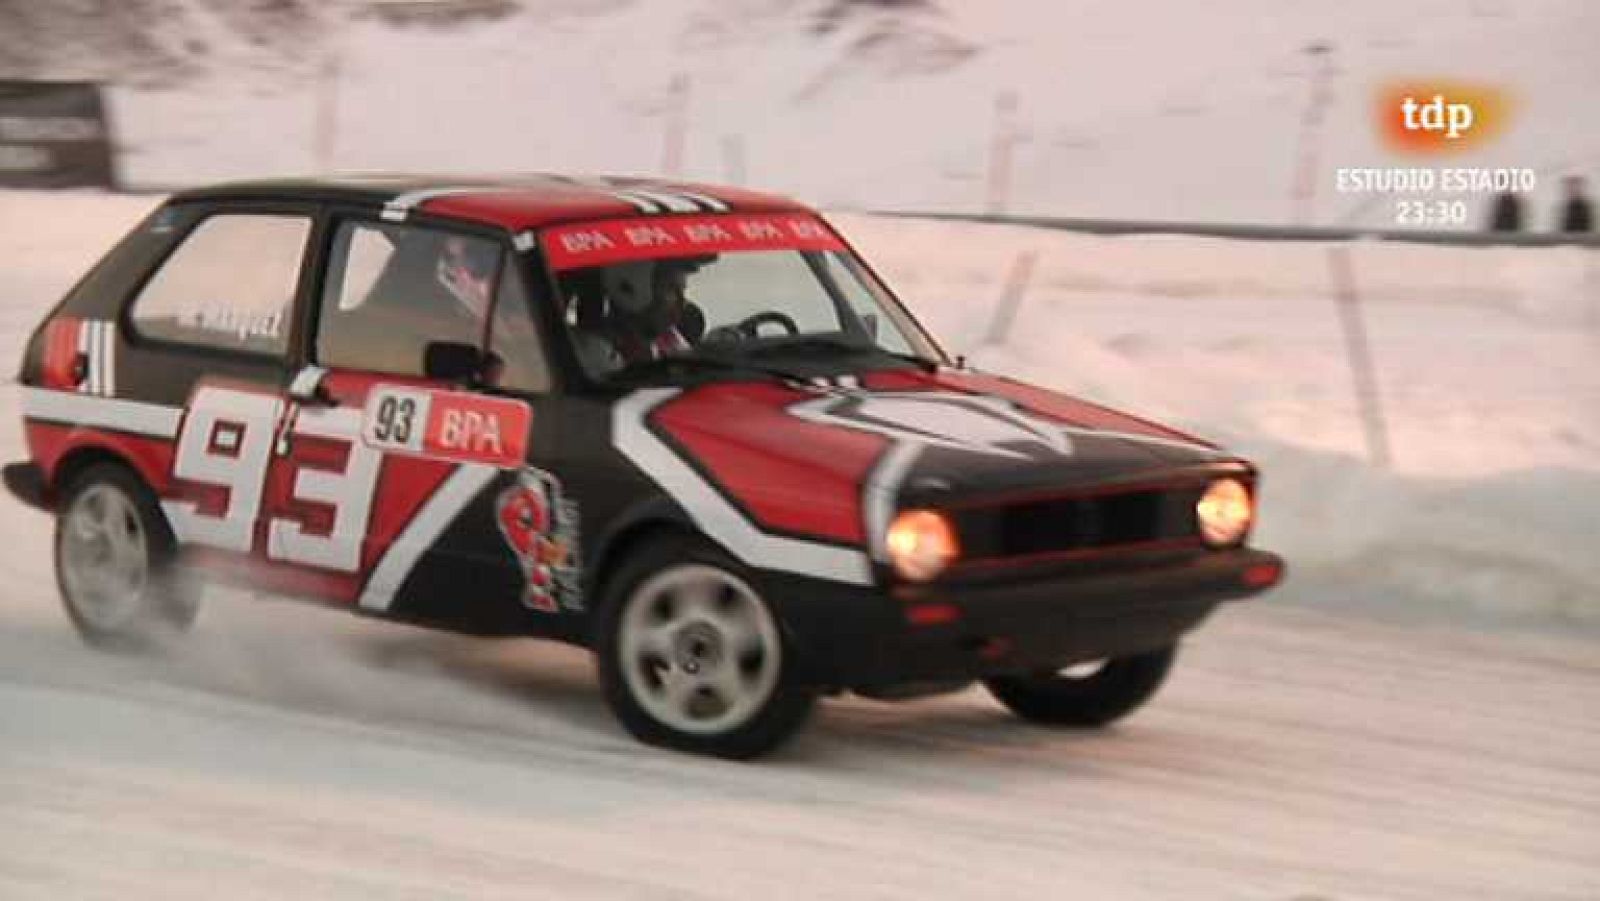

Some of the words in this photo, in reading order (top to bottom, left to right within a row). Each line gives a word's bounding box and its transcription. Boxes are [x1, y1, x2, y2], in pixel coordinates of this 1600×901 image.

[373, 395, 416, 444] 93
[440, 408, 503, 455] BPA
[158, 385, 384, 573] 93
